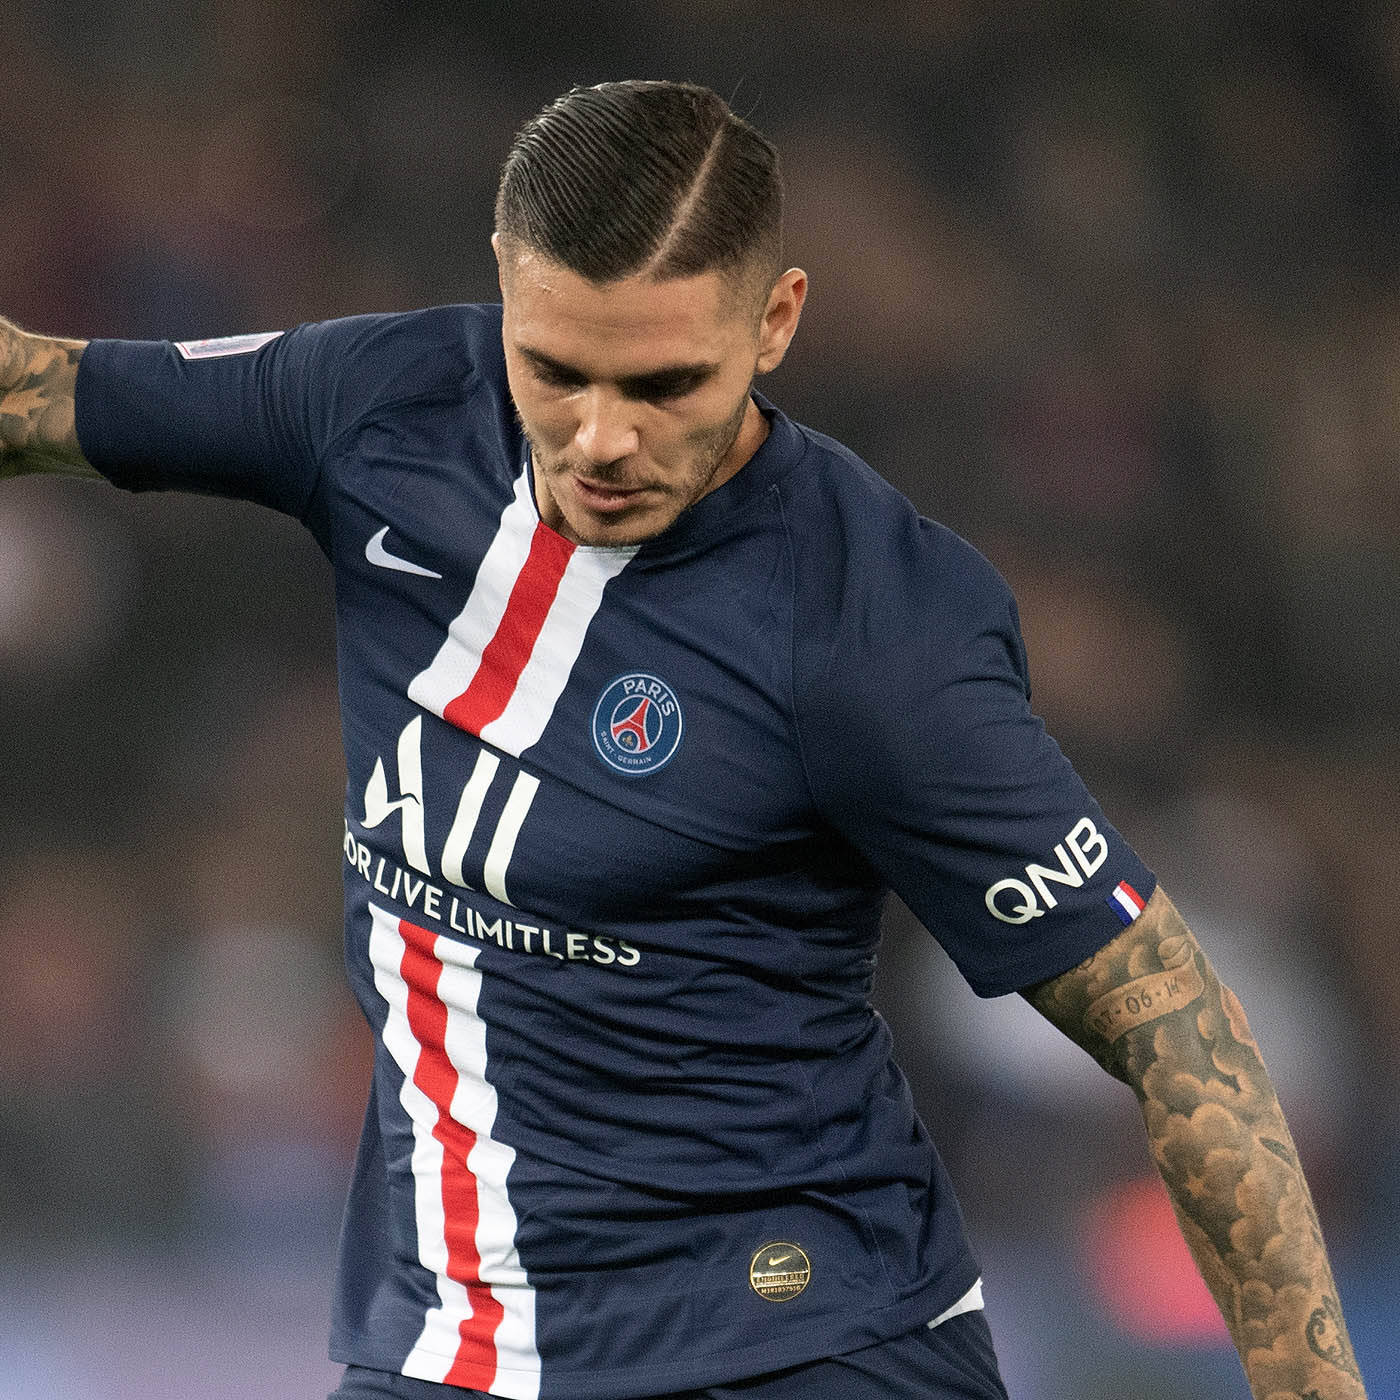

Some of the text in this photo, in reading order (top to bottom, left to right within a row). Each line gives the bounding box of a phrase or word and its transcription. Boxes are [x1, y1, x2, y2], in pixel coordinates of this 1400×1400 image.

[622, 679, 676, 717] PARIS
[617, 754, 653, 766] GERMAIN
[343, 818, 642, 967] OR LIVE LIMITLESS
[984, 816, 1109, 925] QNB
